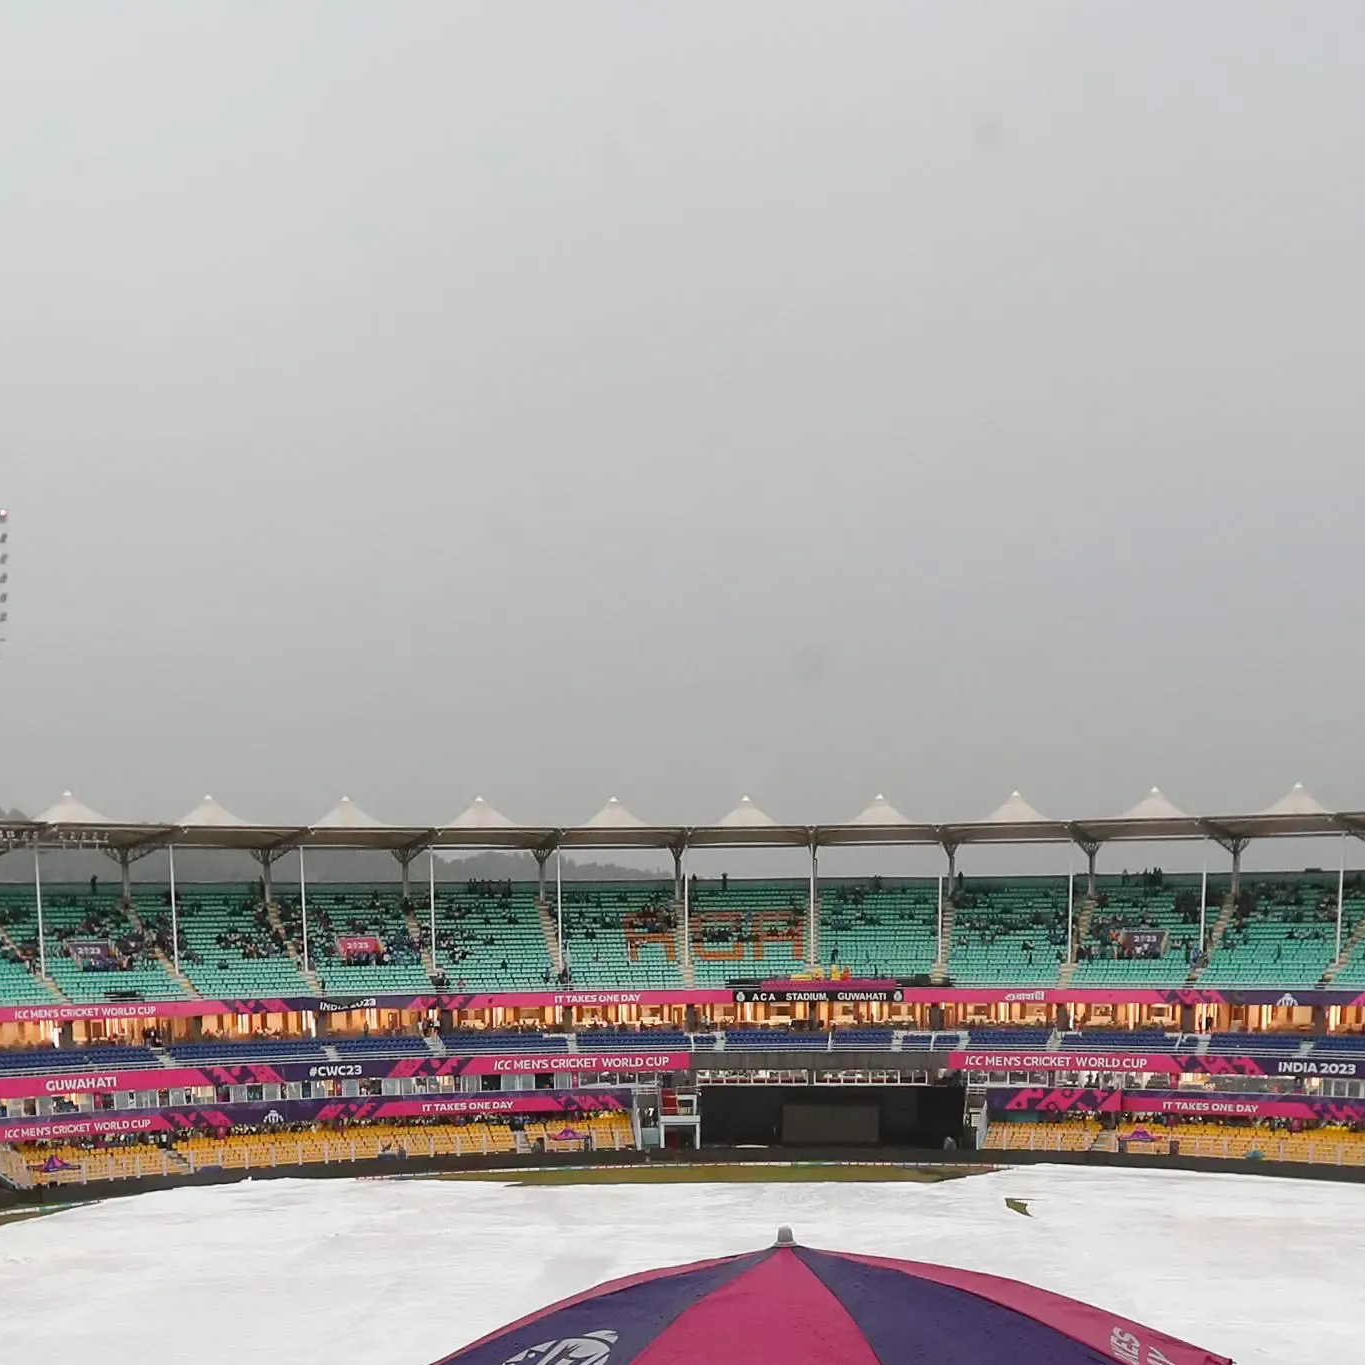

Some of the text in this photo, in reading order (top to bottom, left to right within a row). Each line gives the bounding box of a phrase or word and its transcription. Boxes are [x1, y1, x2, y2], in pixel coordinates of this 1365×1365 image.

[618, 994, 640, 1002] DAY
[750, 993, 778, 1003] ACA
[838, 992, 886, 1003] GUWAHATI
[15, 1005, 156, 1019] ICC MEN'S CRICKET WORLD CUP
[494, 1057, 669, 1070] ICC MEN'S CRICKET WORLD CUP
[965, 1056, 1147, 1068] ICC MEN'S CRICKET WORLD CUP
[1279, 1062, 1356, 1074] INDIA 2023
[307, 1061, 362, 1076] #CWC23
[44, 1075, 119, 1093] GUWAHATI
[423, 1104, 431, 1112] IT
[431, 1103, 467, 1111] TAKES
[493, 1101, 513, 1109] DAY
[1175, 1102, 1209, 1110] TAKES
[1212, 1104, 1234, 1112] ONE
[5, 1119, 150, 1139] ICC MEN'S CRICKET WORLD CUP
